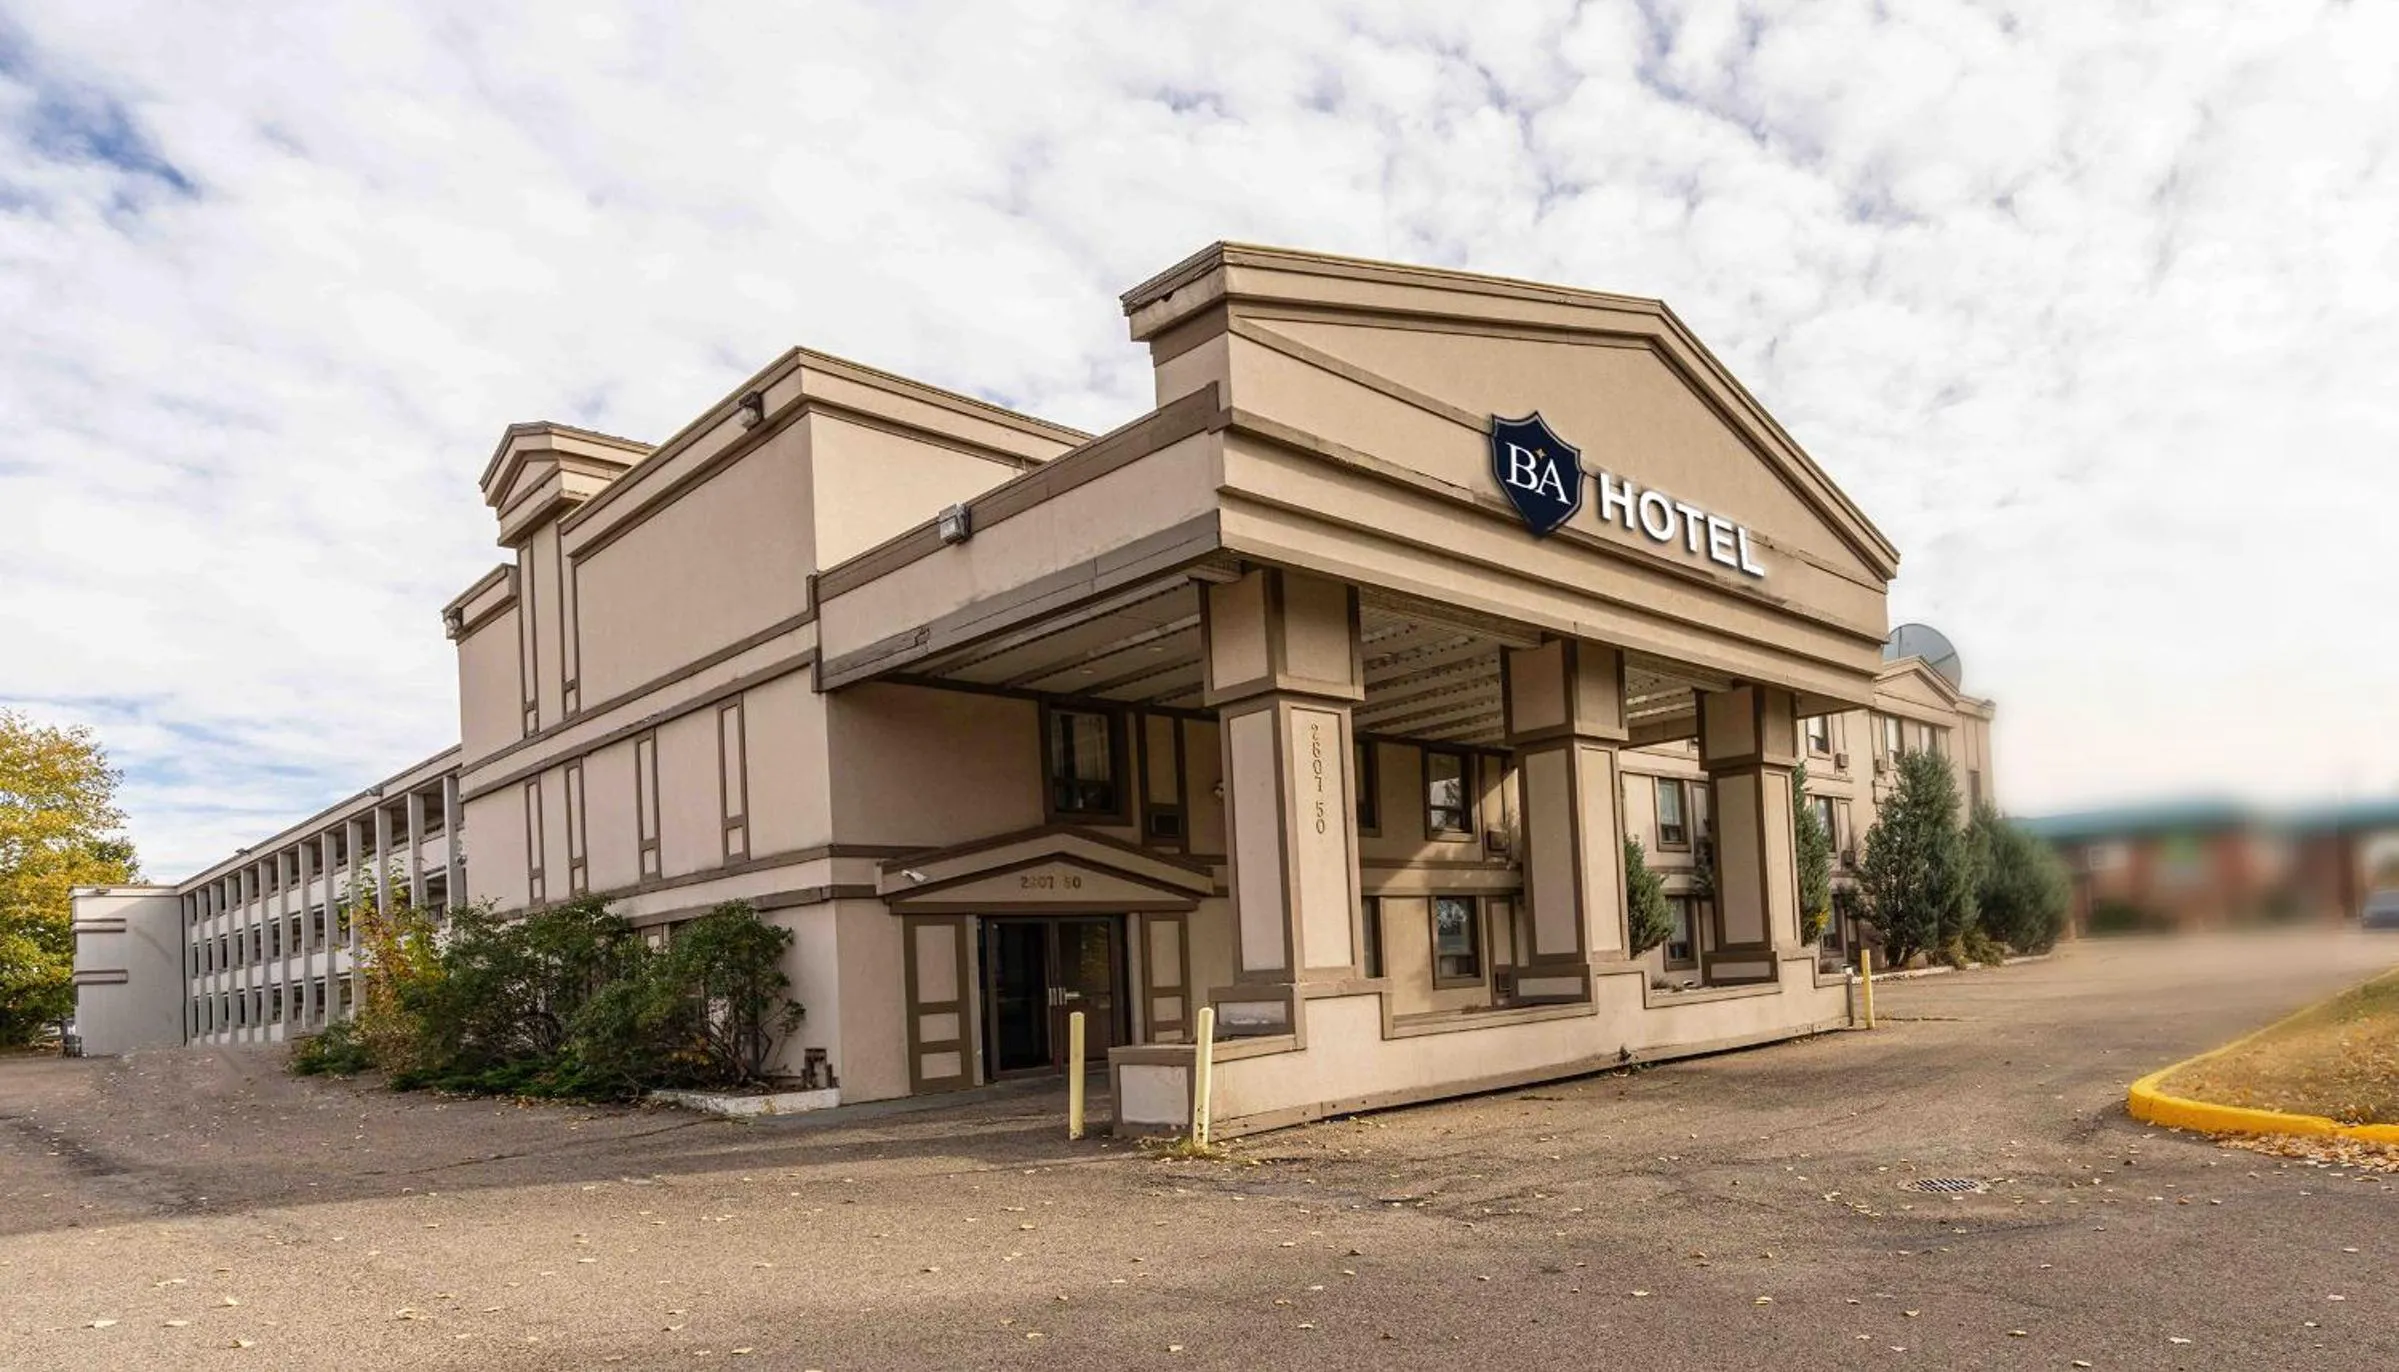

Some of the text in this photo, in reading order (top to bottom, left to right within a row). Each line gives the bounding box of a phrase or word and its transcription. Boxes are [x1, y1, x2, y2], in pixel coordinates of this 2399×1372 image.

[1505, 442, 1765, 577] BA HOTEL
[1315, 800, 1325, 834] 50
